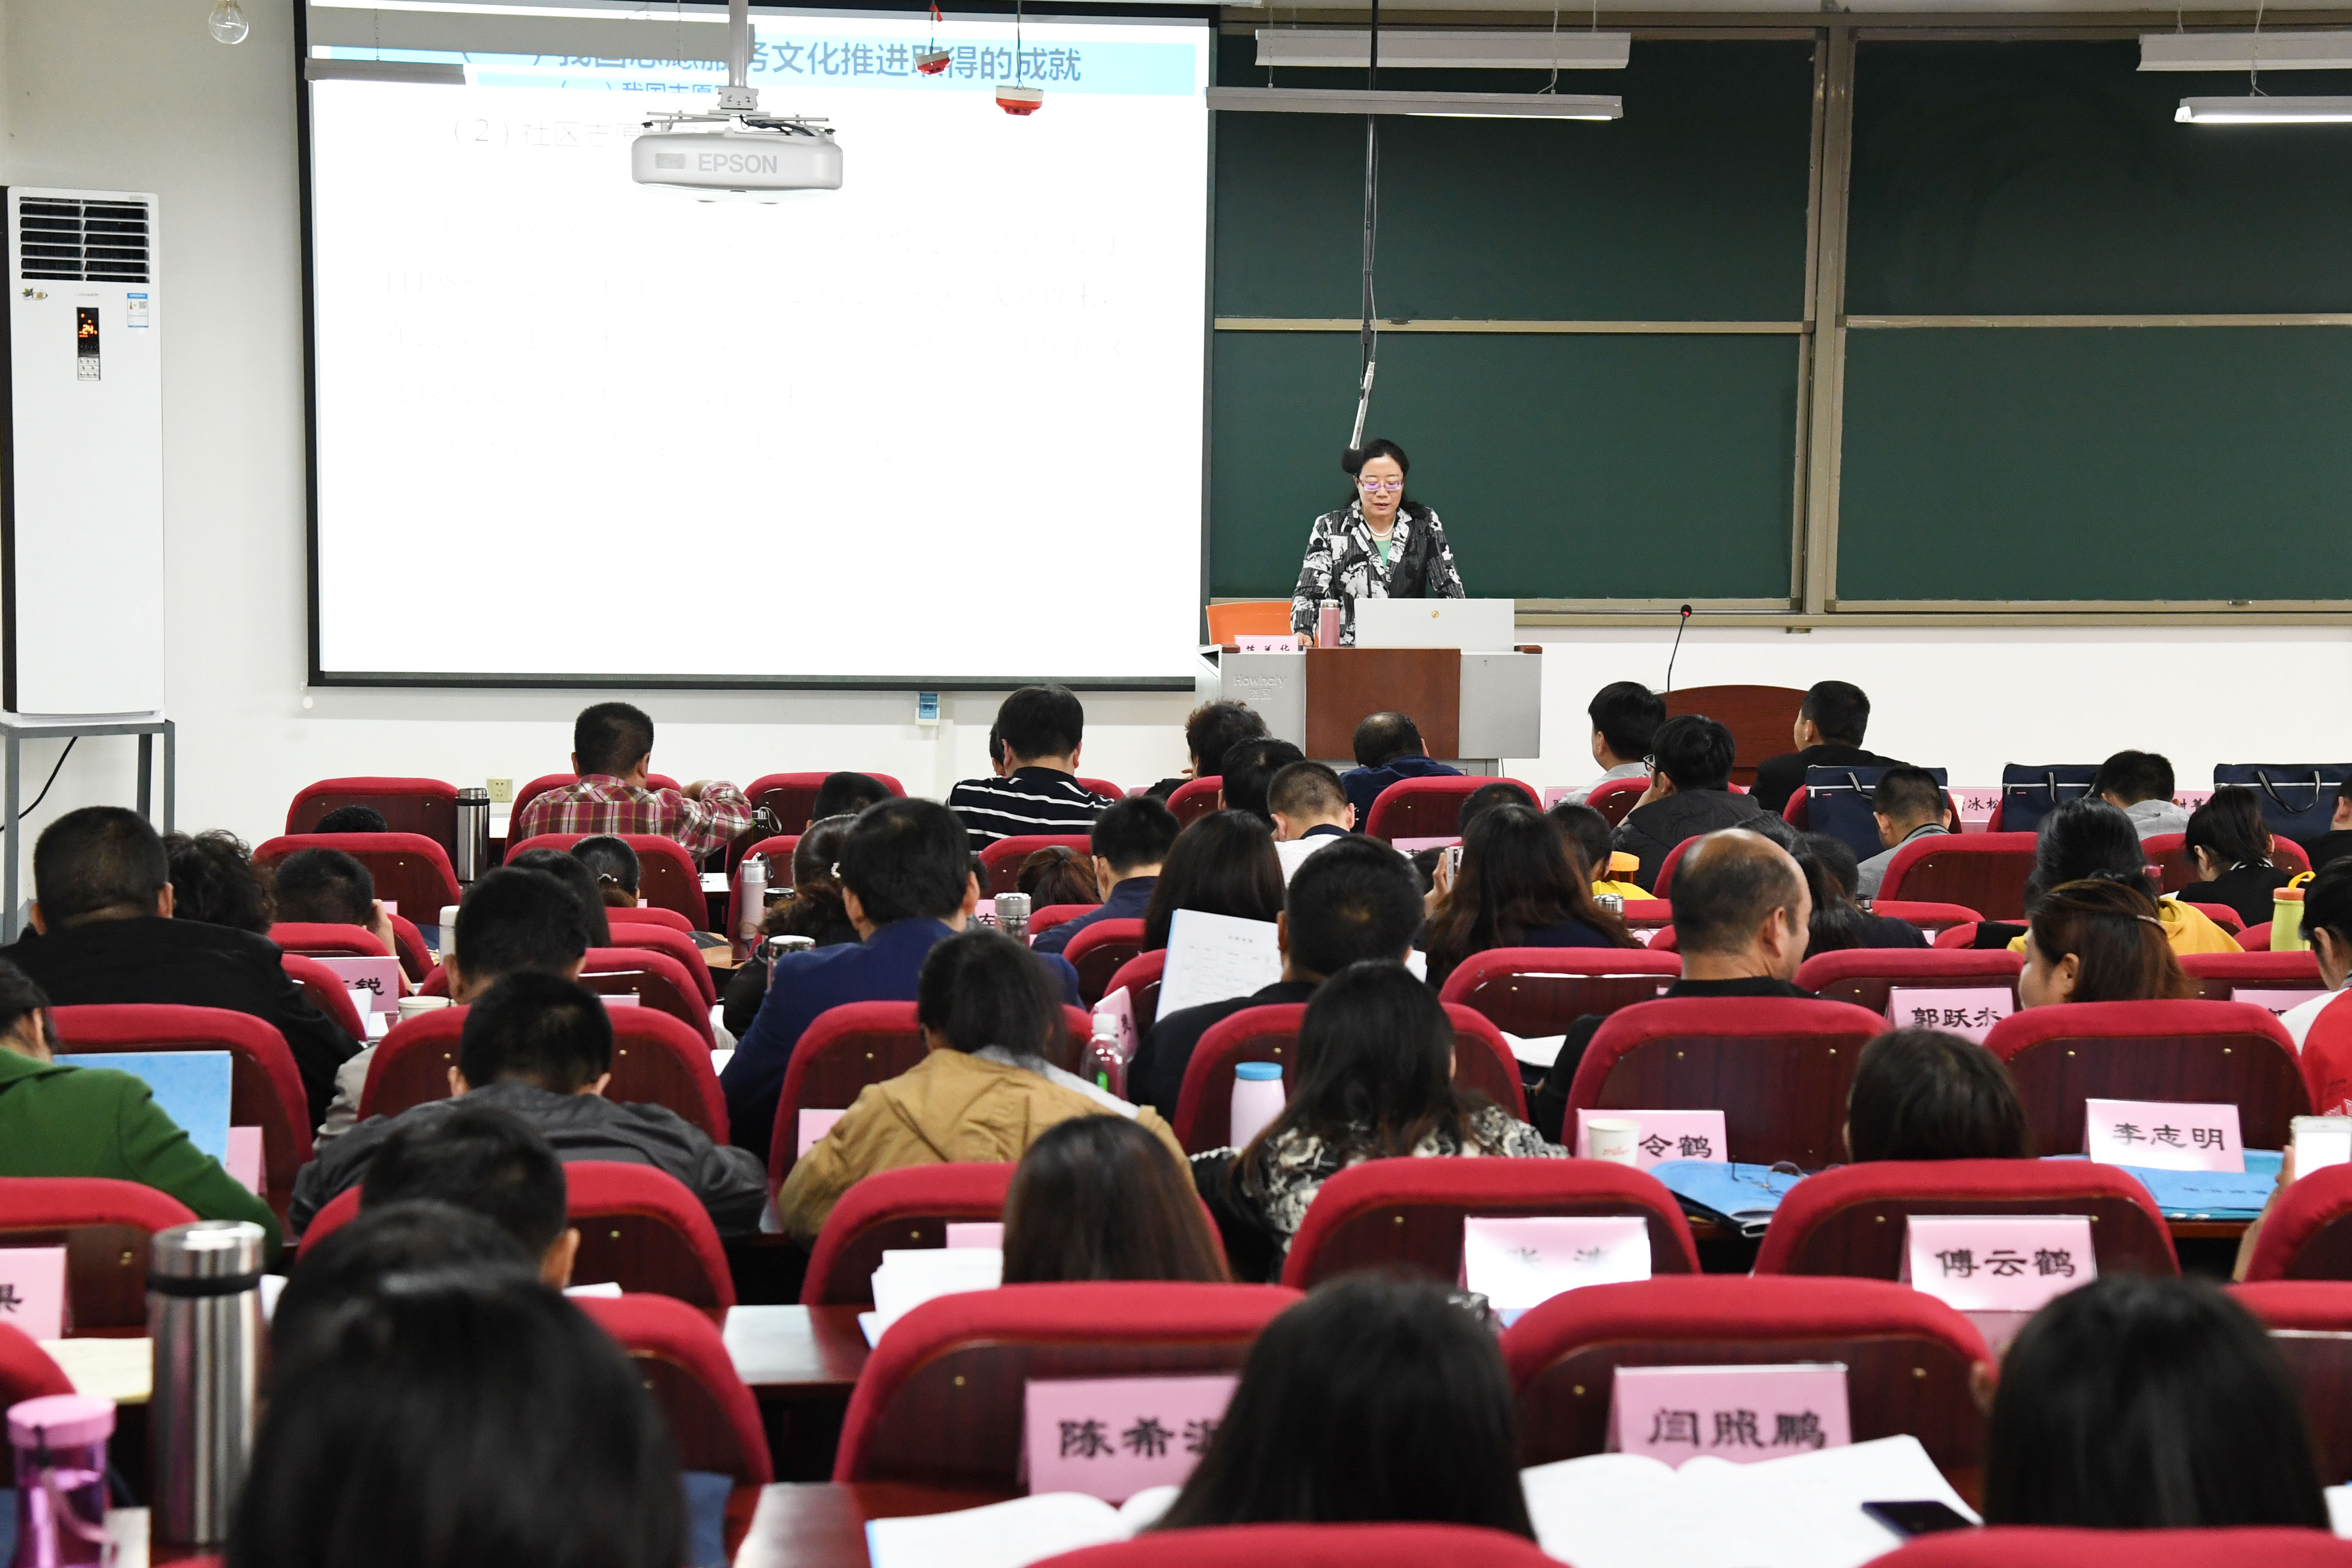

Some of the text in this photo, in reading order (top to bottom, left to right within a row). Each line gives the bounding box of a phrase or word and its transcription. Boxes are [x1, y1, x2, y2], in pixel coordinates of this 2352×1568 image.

[698, 153, 777, 174] EPSON
[1962, 797, 2000, 811] 冰松
[343, 977, 385, 996] 锐
[2112, 1122, 2225, 1151] 李志明
[1935, 1243, 2076, 1278] 傅云鹤
